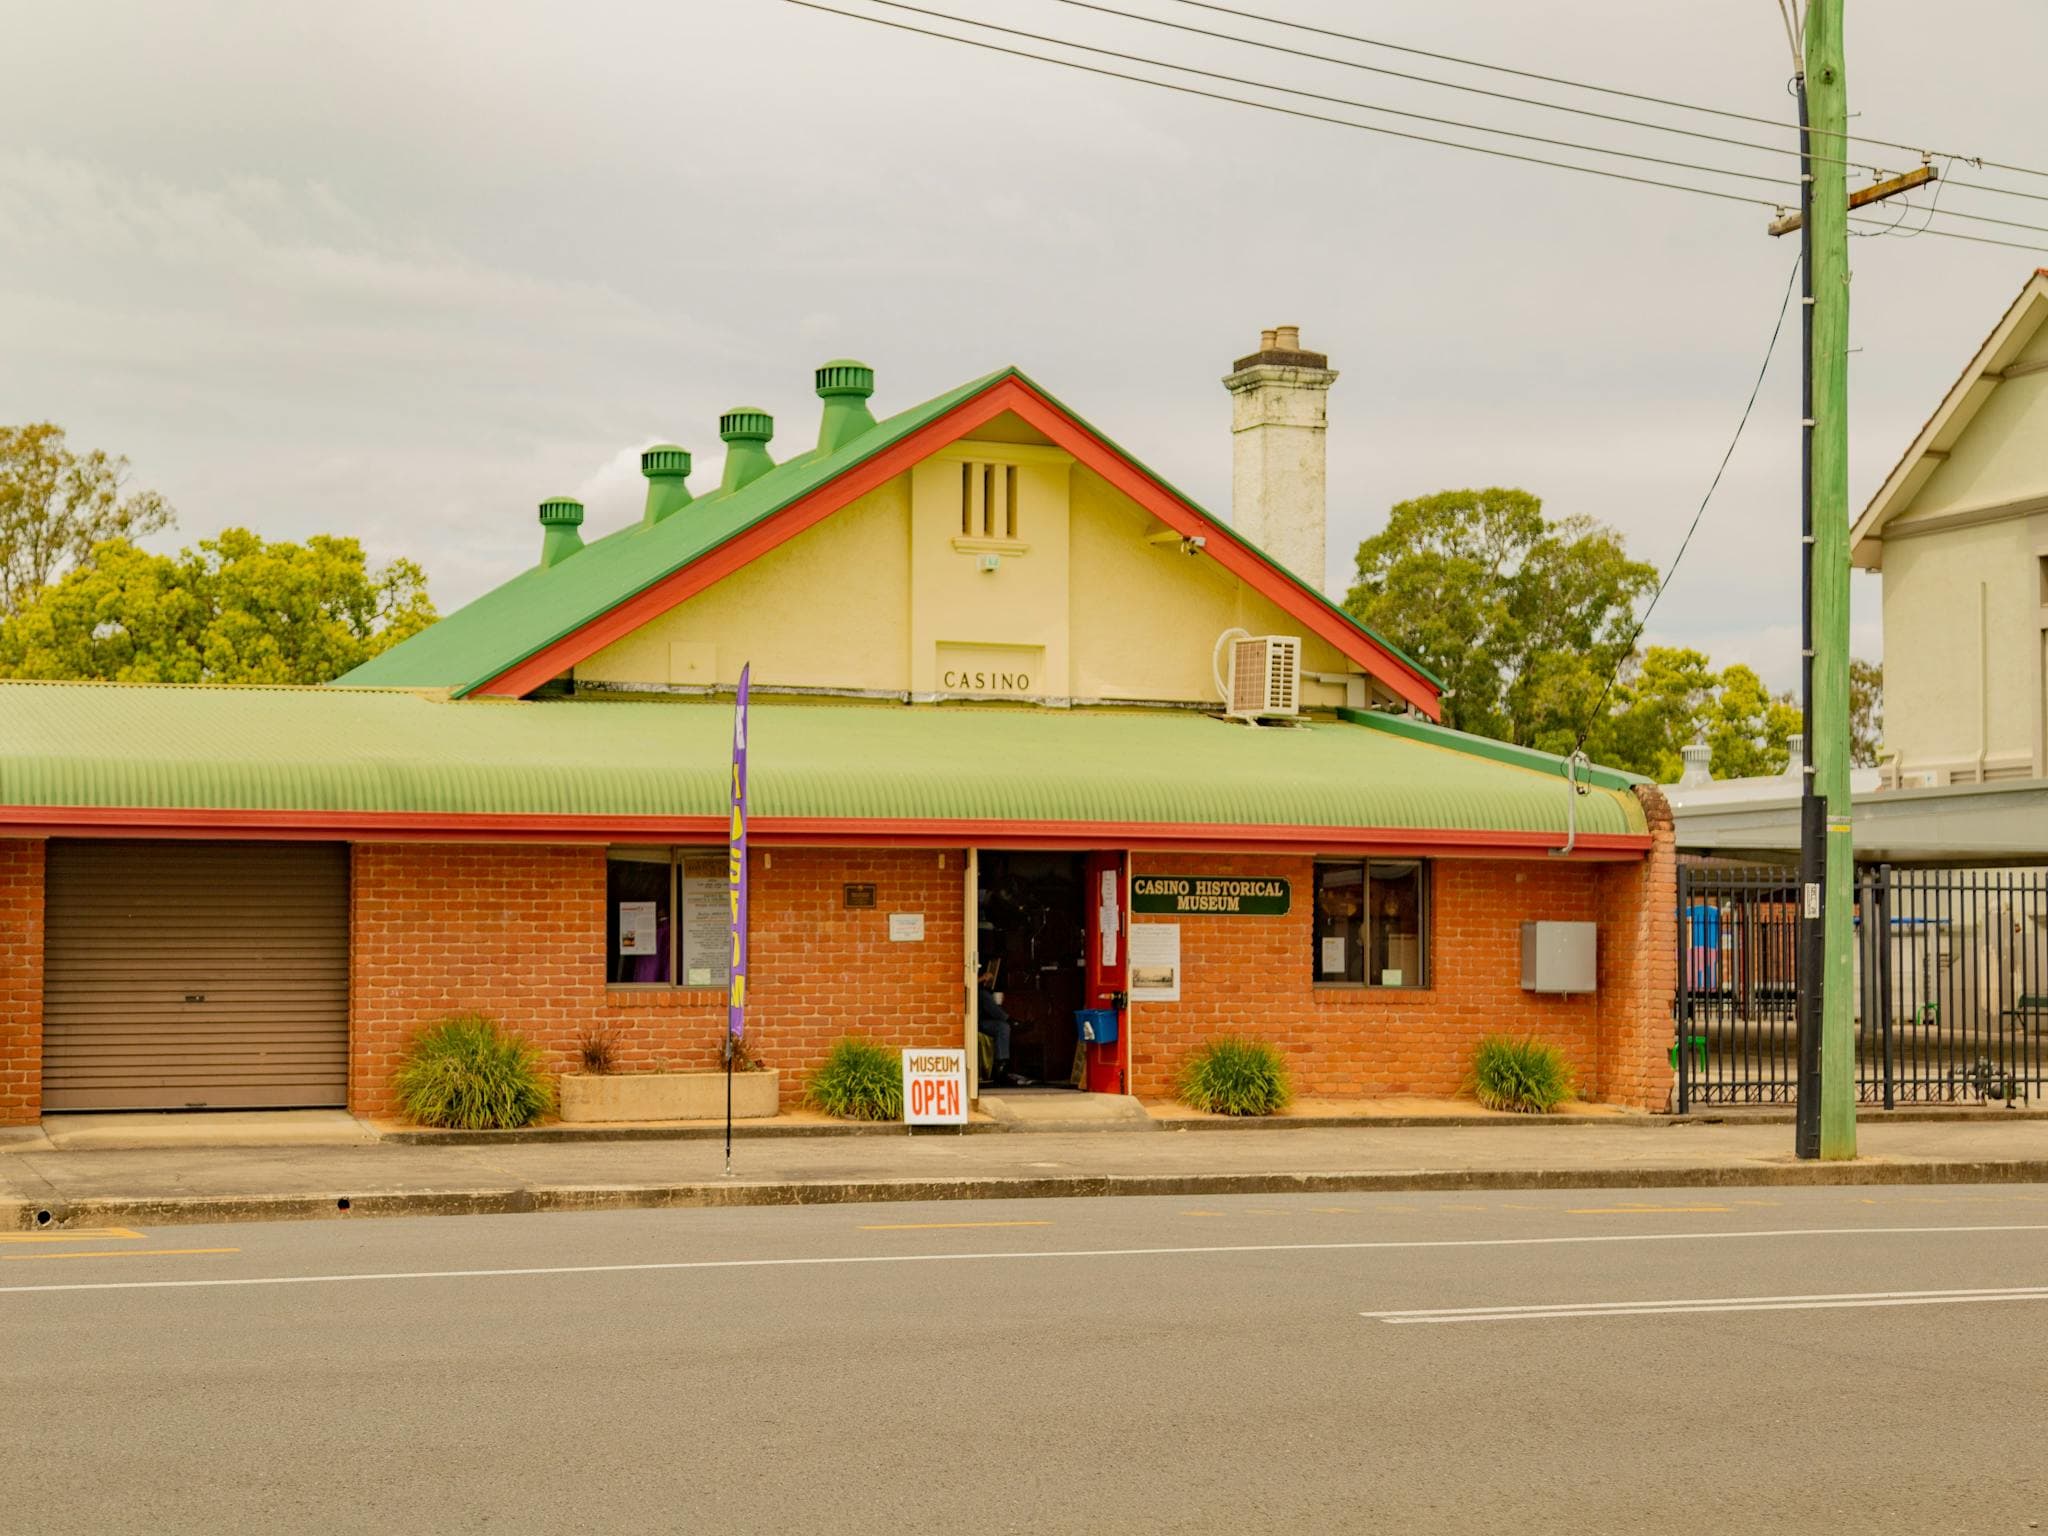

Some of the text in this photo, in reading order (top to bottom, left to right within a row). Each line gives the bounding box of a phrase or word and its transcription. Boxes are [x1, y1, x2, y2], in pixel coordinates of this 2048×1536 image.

[944, 671, 1029, 690] CASINO
[1135, 880, 1284, 897] CASINO HISTORICAL
[1177, 896, 1240, 911] MUSEUM
[909, 1056, 960, 1072] MUSEUM
[911, 1079, 960, 1116] OPEN
